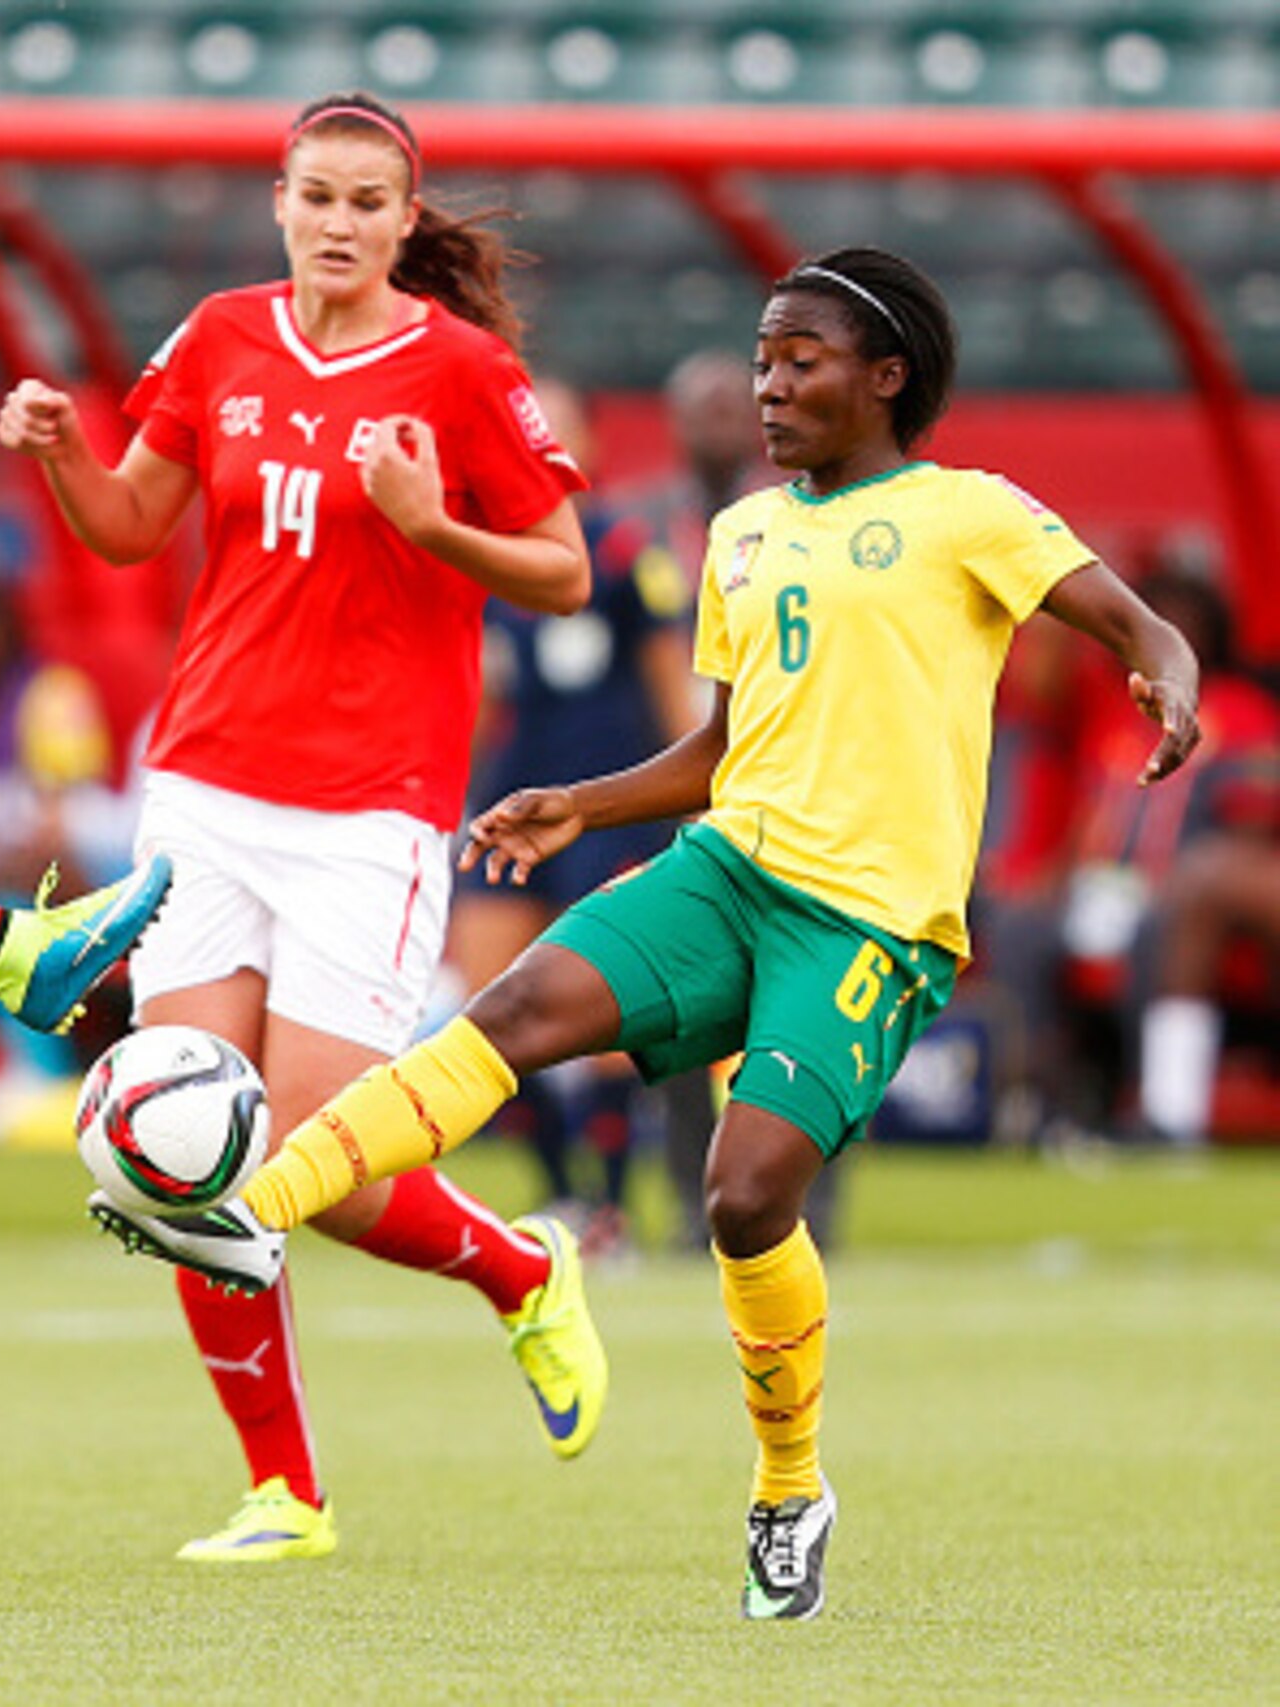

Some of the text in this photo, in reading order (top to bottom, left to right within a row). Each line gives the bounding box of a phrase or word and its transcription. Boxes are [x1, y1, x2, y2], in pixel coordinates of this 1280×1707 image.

[258, 460, 323, 559] 14
[776, 584, 810, 673] 6
[835, 939, 894, 1022] 6
